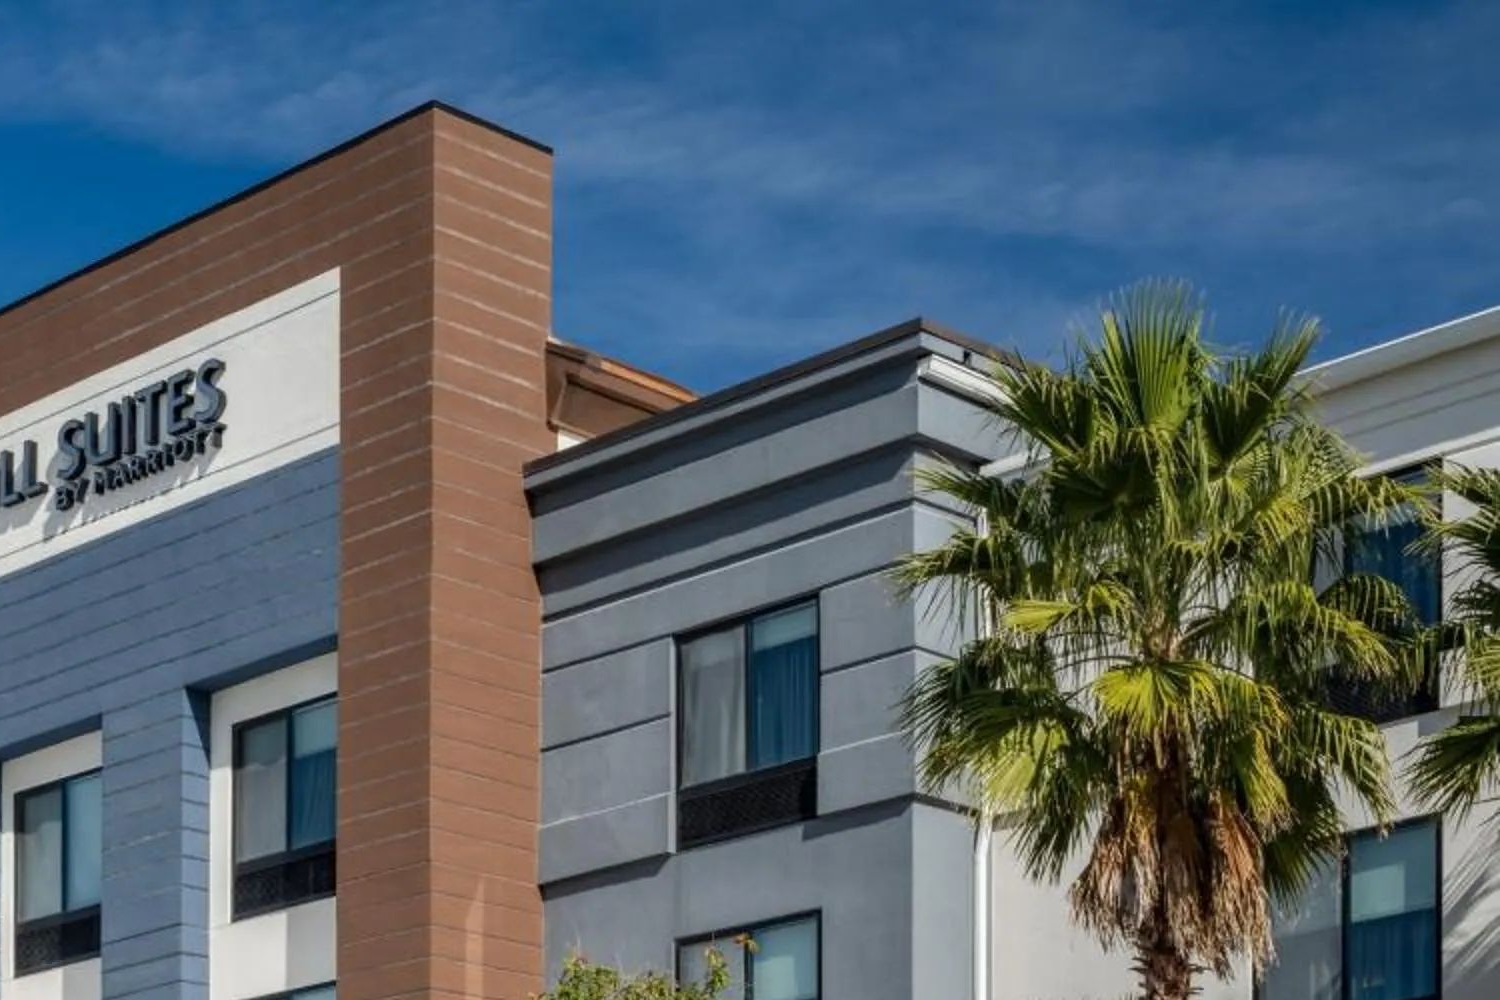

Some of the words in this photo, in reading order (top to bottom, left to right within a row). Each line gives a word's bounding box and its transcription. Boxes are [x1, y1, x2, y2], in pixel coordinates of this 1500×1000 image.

[55, 478, 90, 511] BY
[93, 423, 228, 495] MARRIOTT
[57, 358, 227, 480] SUITES
